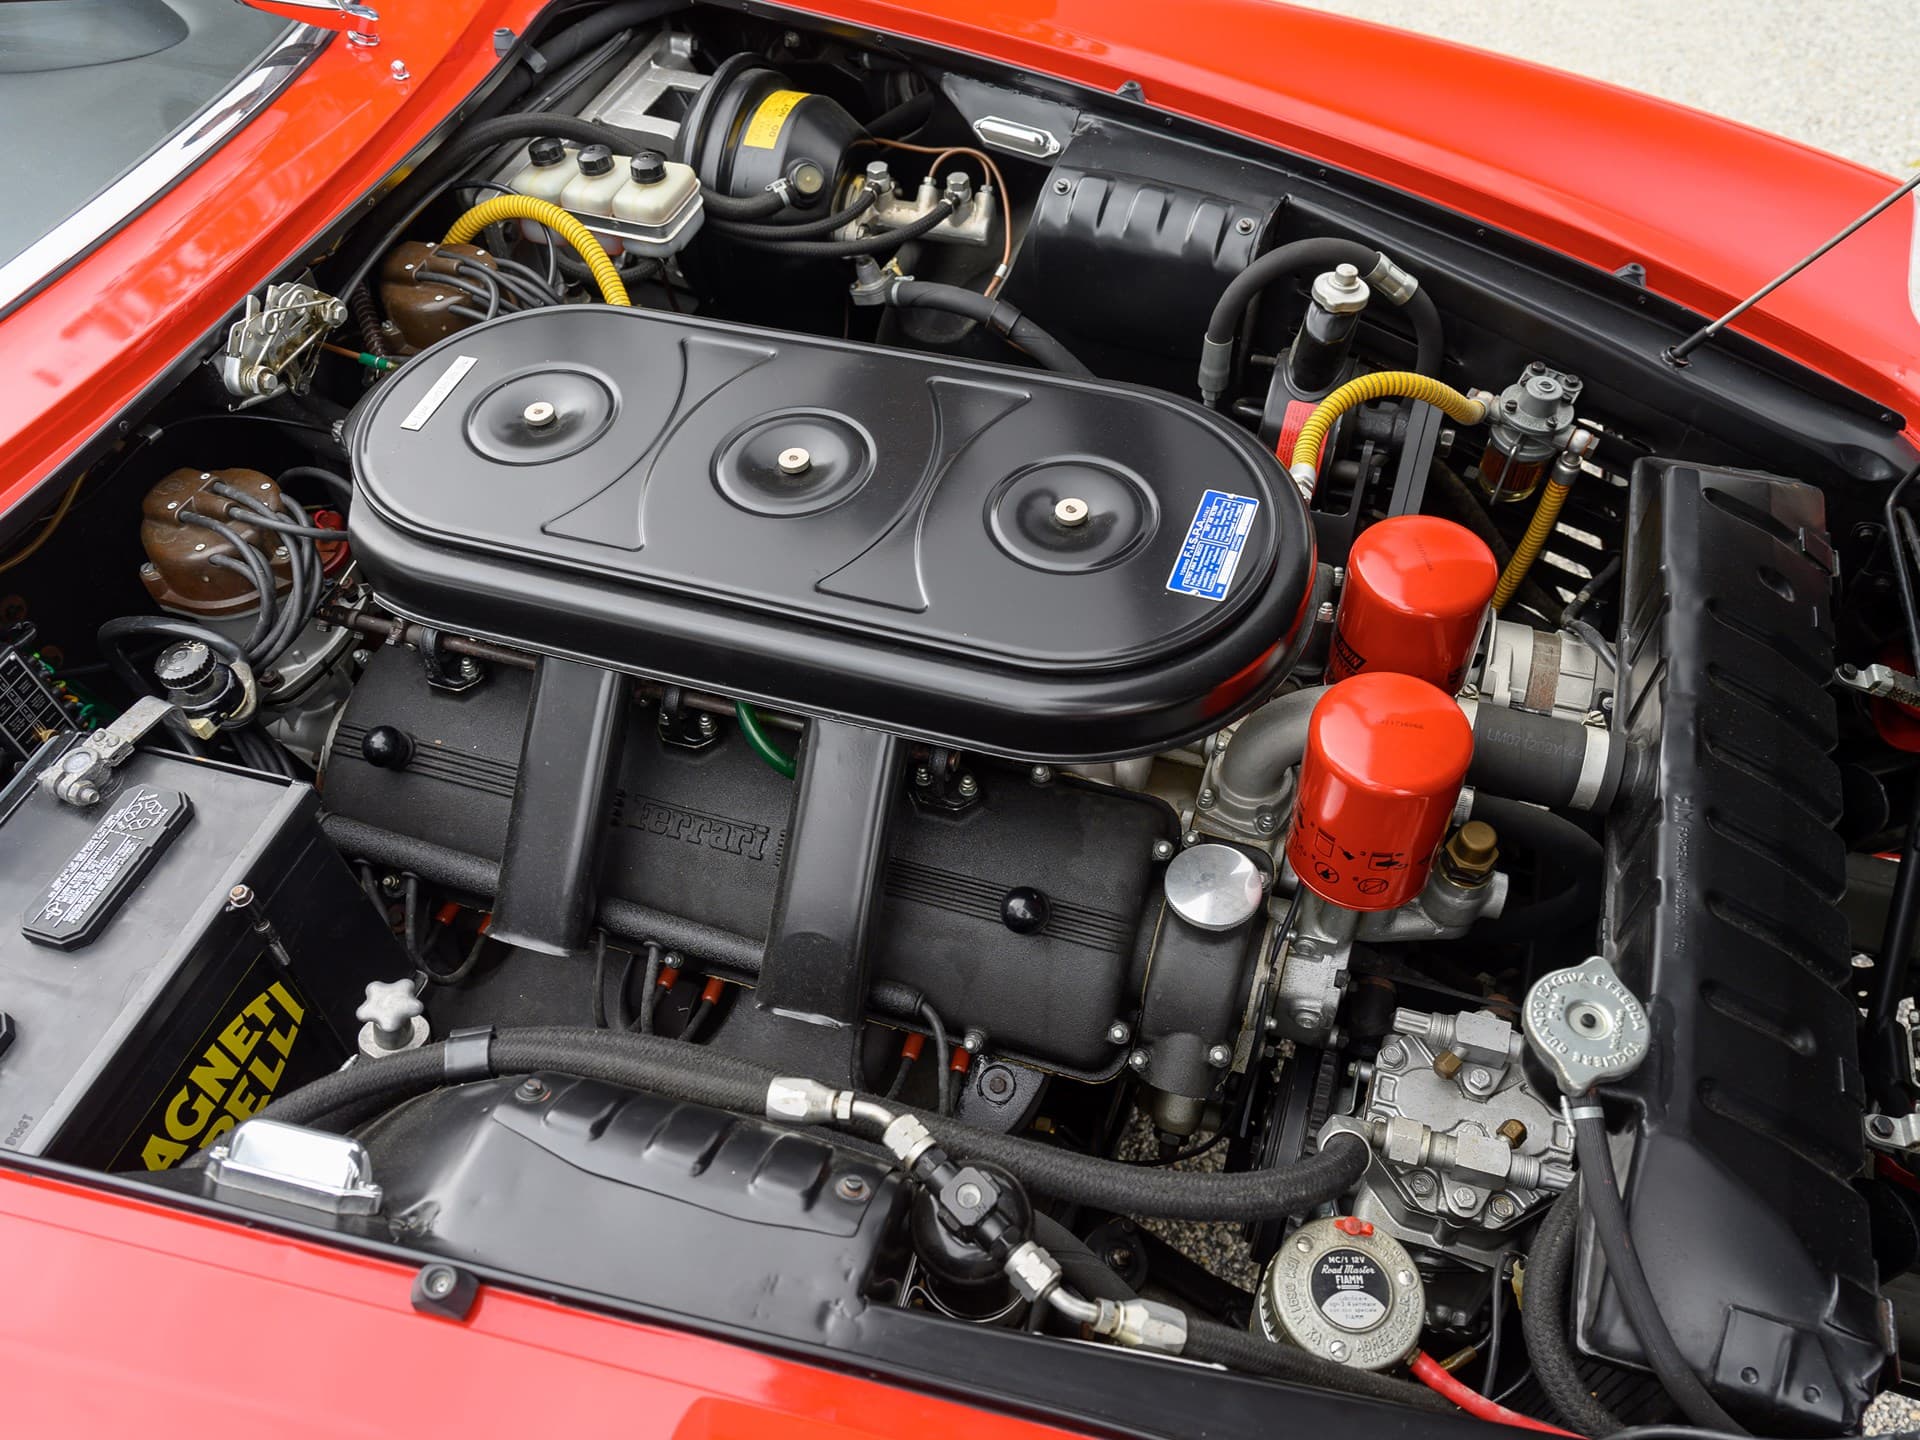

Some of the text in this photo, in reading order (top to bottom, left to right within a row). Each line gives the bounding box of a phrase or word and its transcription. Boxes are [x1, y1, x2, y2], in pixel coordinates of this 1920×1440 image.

[626, 794, 771, 861] Ferrari
[1605, 981, 1645, 1031] FREDDA
[1321, 1264, 1375, 1274] Road Master
[1335, 1275, 1364, 1284] FIAMM
